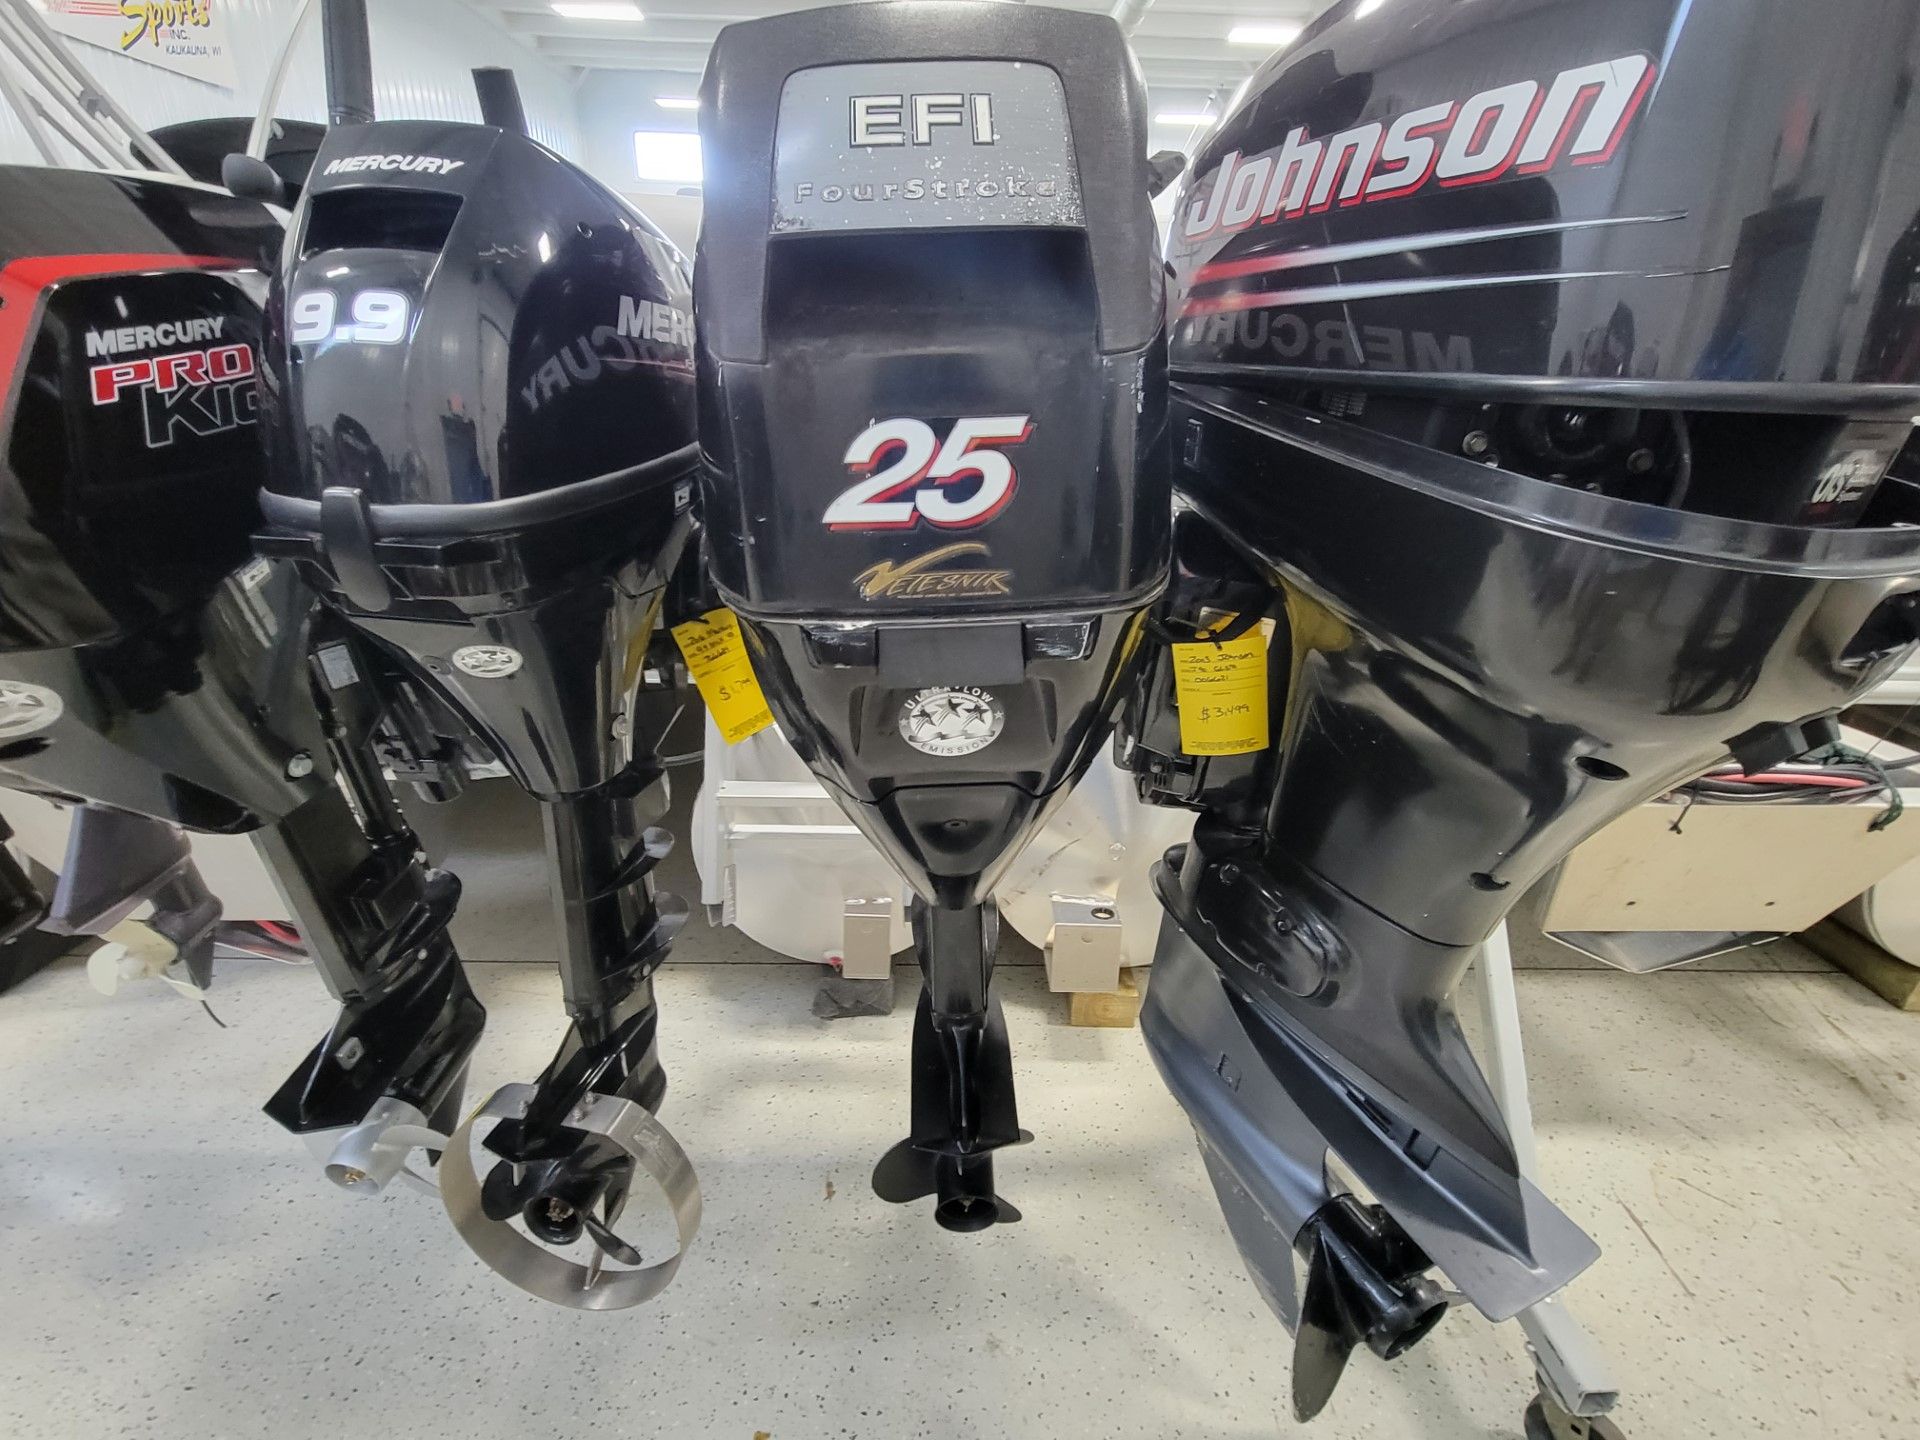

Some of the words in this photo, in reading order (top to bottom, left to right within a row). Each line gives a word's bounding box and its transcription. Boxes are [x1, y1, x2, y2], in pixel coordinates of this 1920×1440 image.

[169, 29, 191, 40] INC.
[849, 93, 995, 149] EFI
[323, 154, 466, 177] MERCURY
[1184, 53, 1657, 244] Johnson
[794, 176, 1058, 204] FourStroke
[85, 316, 225, 358] MERCURY
[290, 290, 410, 346] 9.9
[90, 343, 254, 406] PRO
[822, 415, 1036, 534] 25
[963, 685, 994, 703] LOW
[920, 736, 989, 754] EMISSION
